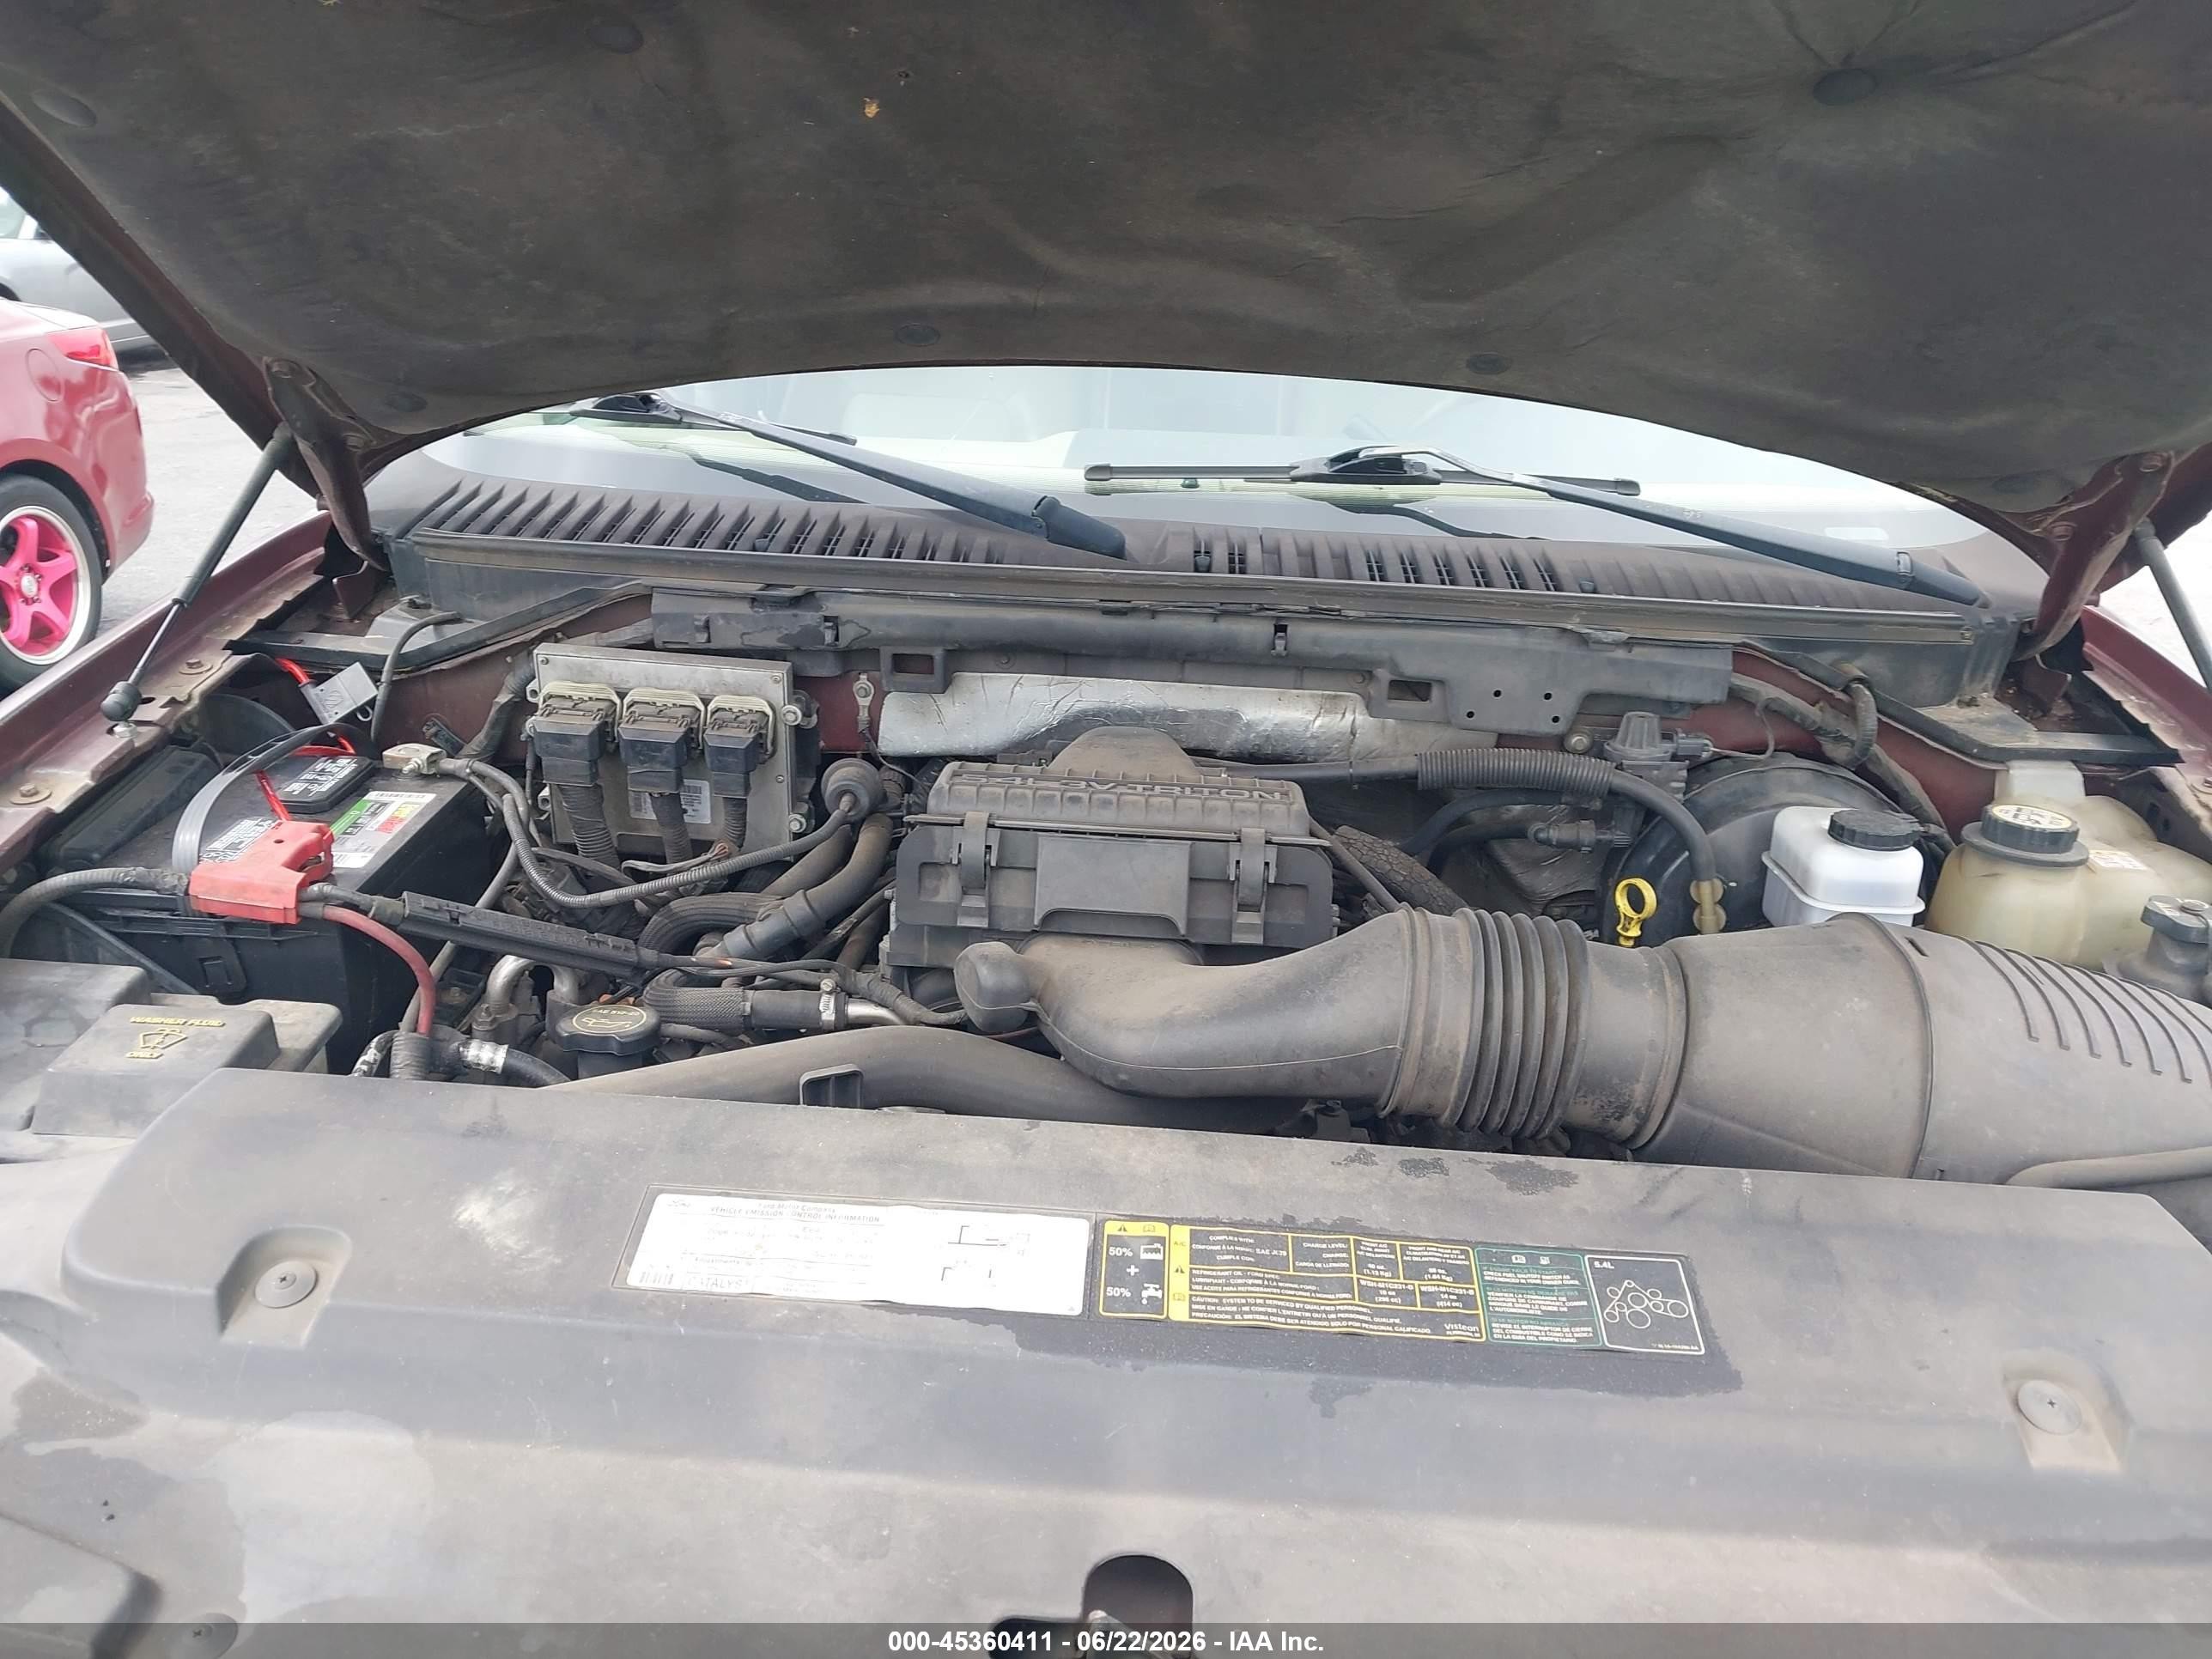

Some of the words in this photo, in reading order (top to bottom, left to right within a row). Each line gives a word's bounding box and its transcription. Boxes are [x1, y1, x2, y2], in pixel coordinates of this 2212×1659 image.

[1060, 779, 1116, 790] 3V
[1129, 783, 1281, 800] TRITON
[130, 1017, 187, 1025] WASHER
[187, 1018, 226, 1027] FLUID
[125, 1051, 164, 1060] ONLY
[710, 1206, 743, 1215] VEHICLE
[745, 1208, 783, 1217] EMISSION
[824, 1214, 880, 1223] INFORMATION
[1109, 1247, 1133, 1257] 50%
[1594, 1261, 1614, 1269] 5.4L
[1106, 1287, 1132, 1297] 50%
[1444, 1323, 1479, 1332] Visteon
